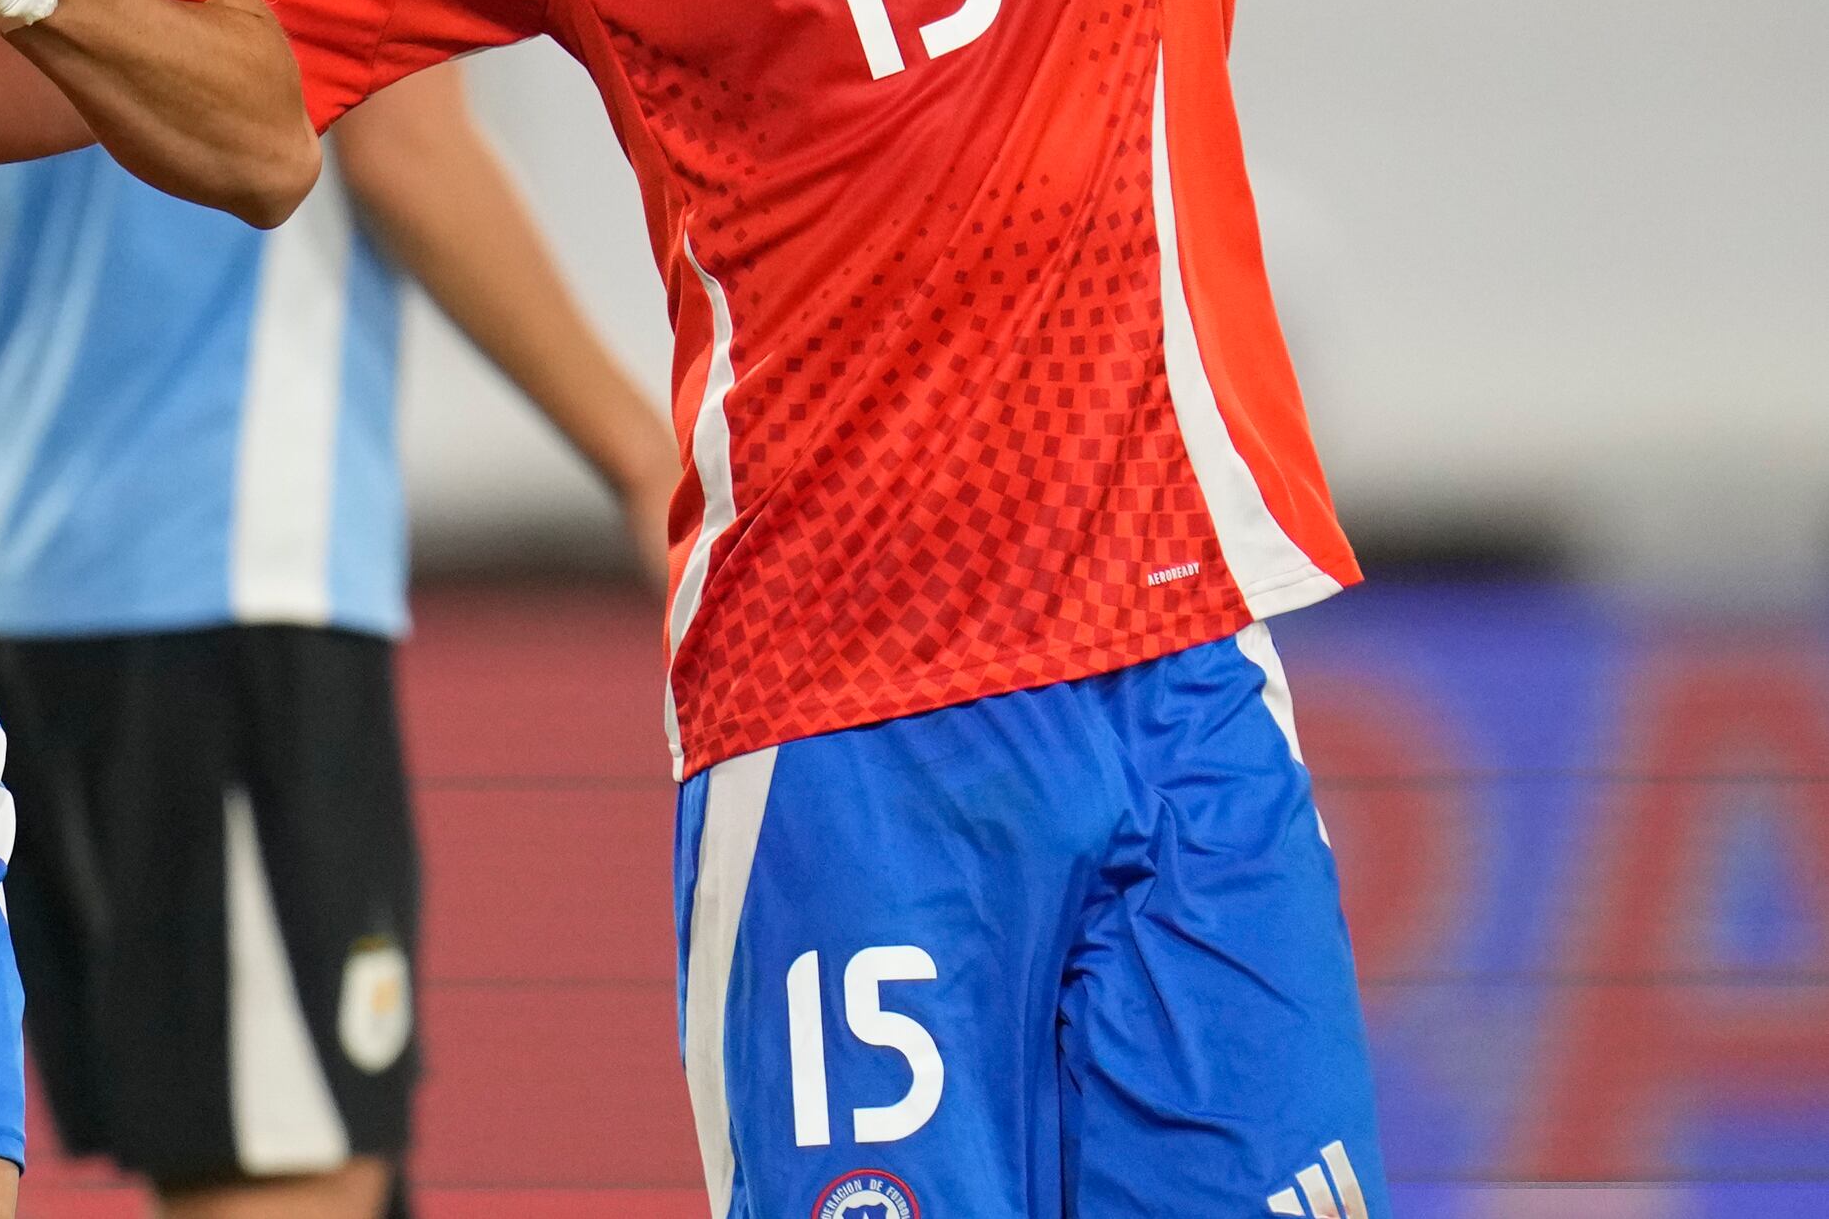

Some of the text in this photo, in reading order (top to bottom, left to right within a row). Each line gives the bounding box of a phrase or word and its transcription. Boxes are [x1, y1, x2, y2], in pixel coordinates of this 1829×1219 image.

[1146, 562, 1200, 587] AEROREADY
[786, 944, 945, 1148] 15
[869, 1178, 884, 1192] DE
